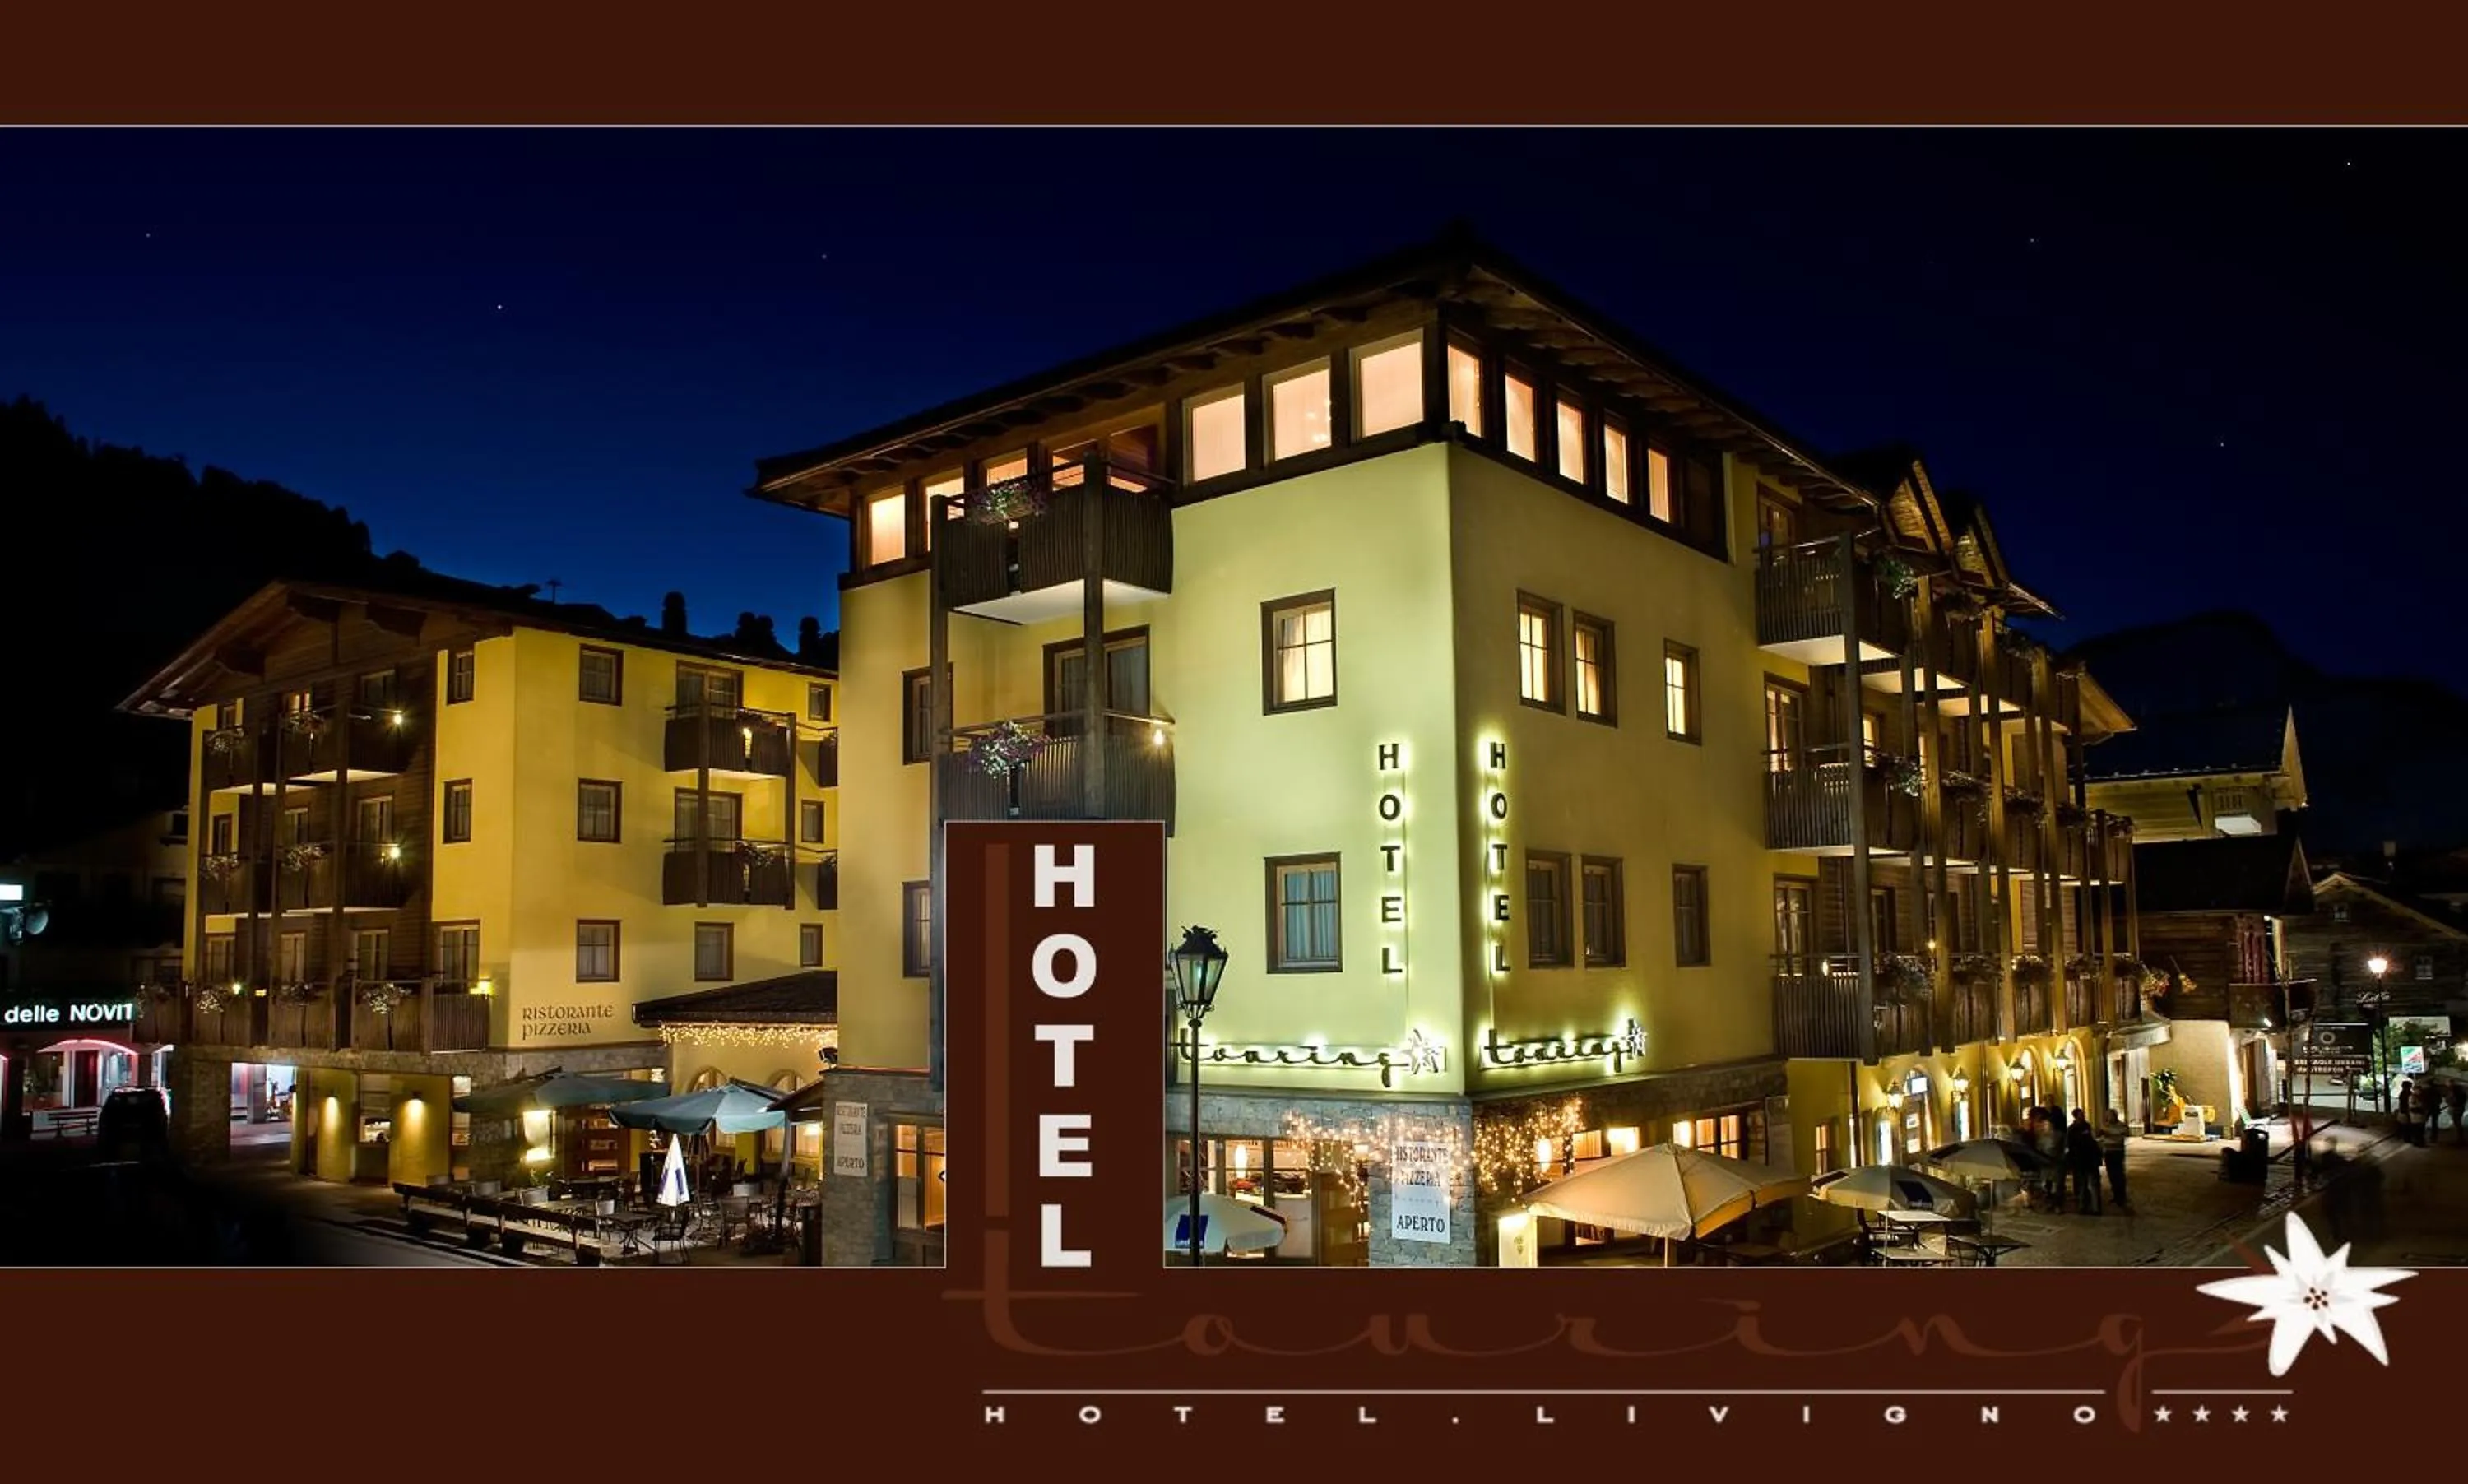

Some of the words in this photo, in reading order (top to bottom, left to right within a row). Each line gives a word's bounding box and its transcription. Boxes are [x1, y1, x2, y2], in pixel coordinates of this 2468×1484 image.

[1379, 743, 1403, 974] HOTEL
[1490, 742, 1510, 972] HOTEL
[4, 1004, 60, 1023] delle
[522, 1004, 614, 1020] RISTORANTE
[522, 1022, 591, 1040] PIZZERIA
[1397, 1215, 1445, 1233] APERTO
